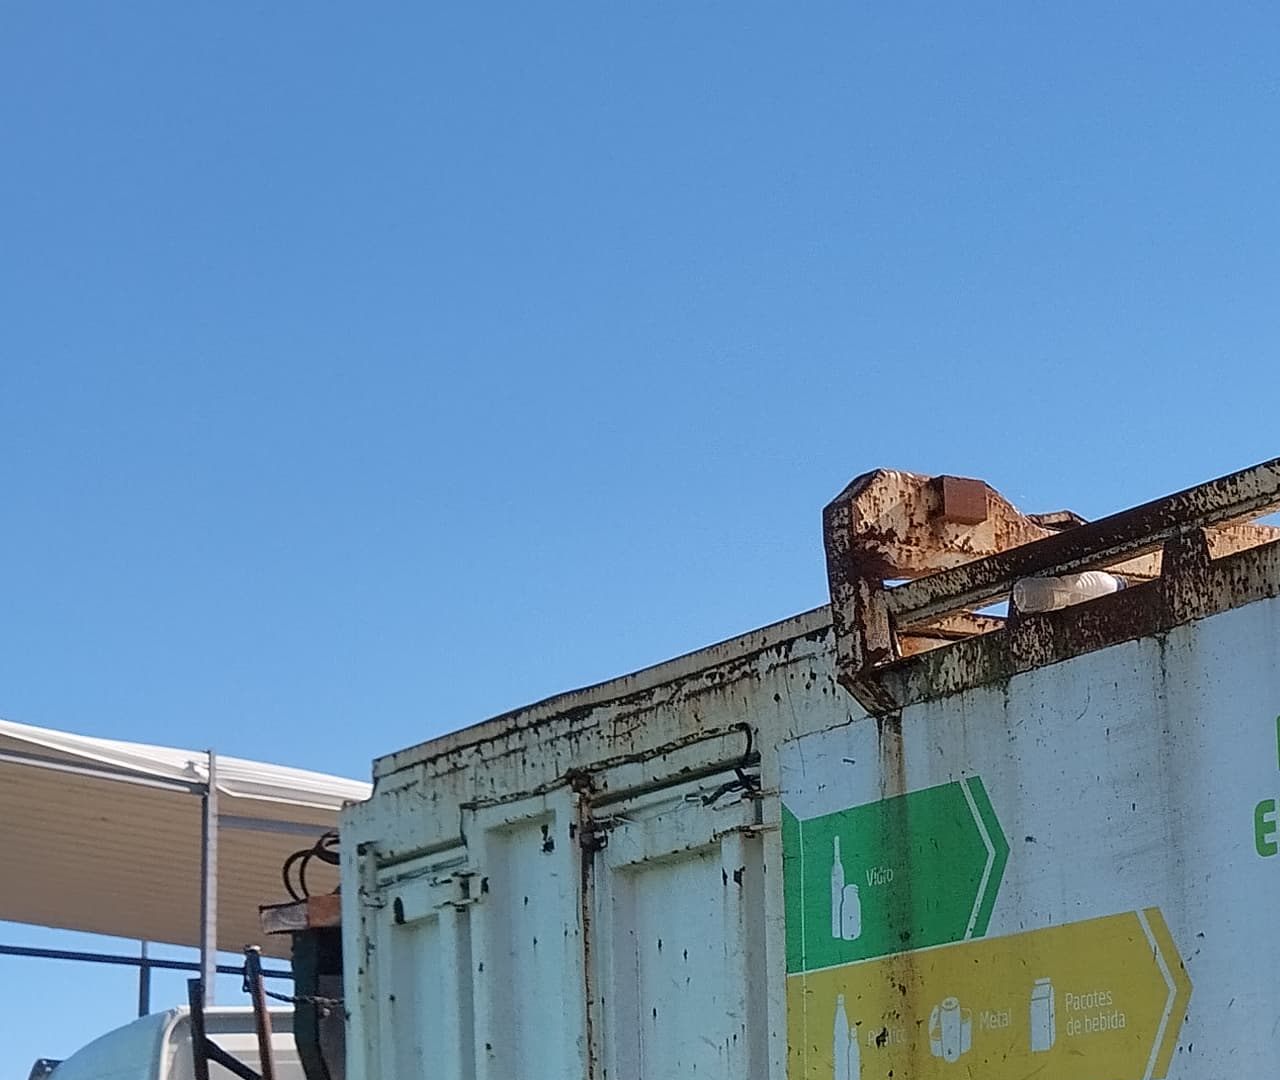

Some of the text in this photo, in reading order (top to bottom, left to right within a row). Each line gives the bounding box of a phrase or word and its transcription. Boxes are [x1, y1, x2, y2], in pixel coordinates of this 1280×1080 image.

[865, 865, 895, 887] Vidro
[1065, 990, 1113, 1012] Pacotes
[979, 1010, 1013, 1031] Metal
[1066, 1010, 1127, 1037] de bebida
